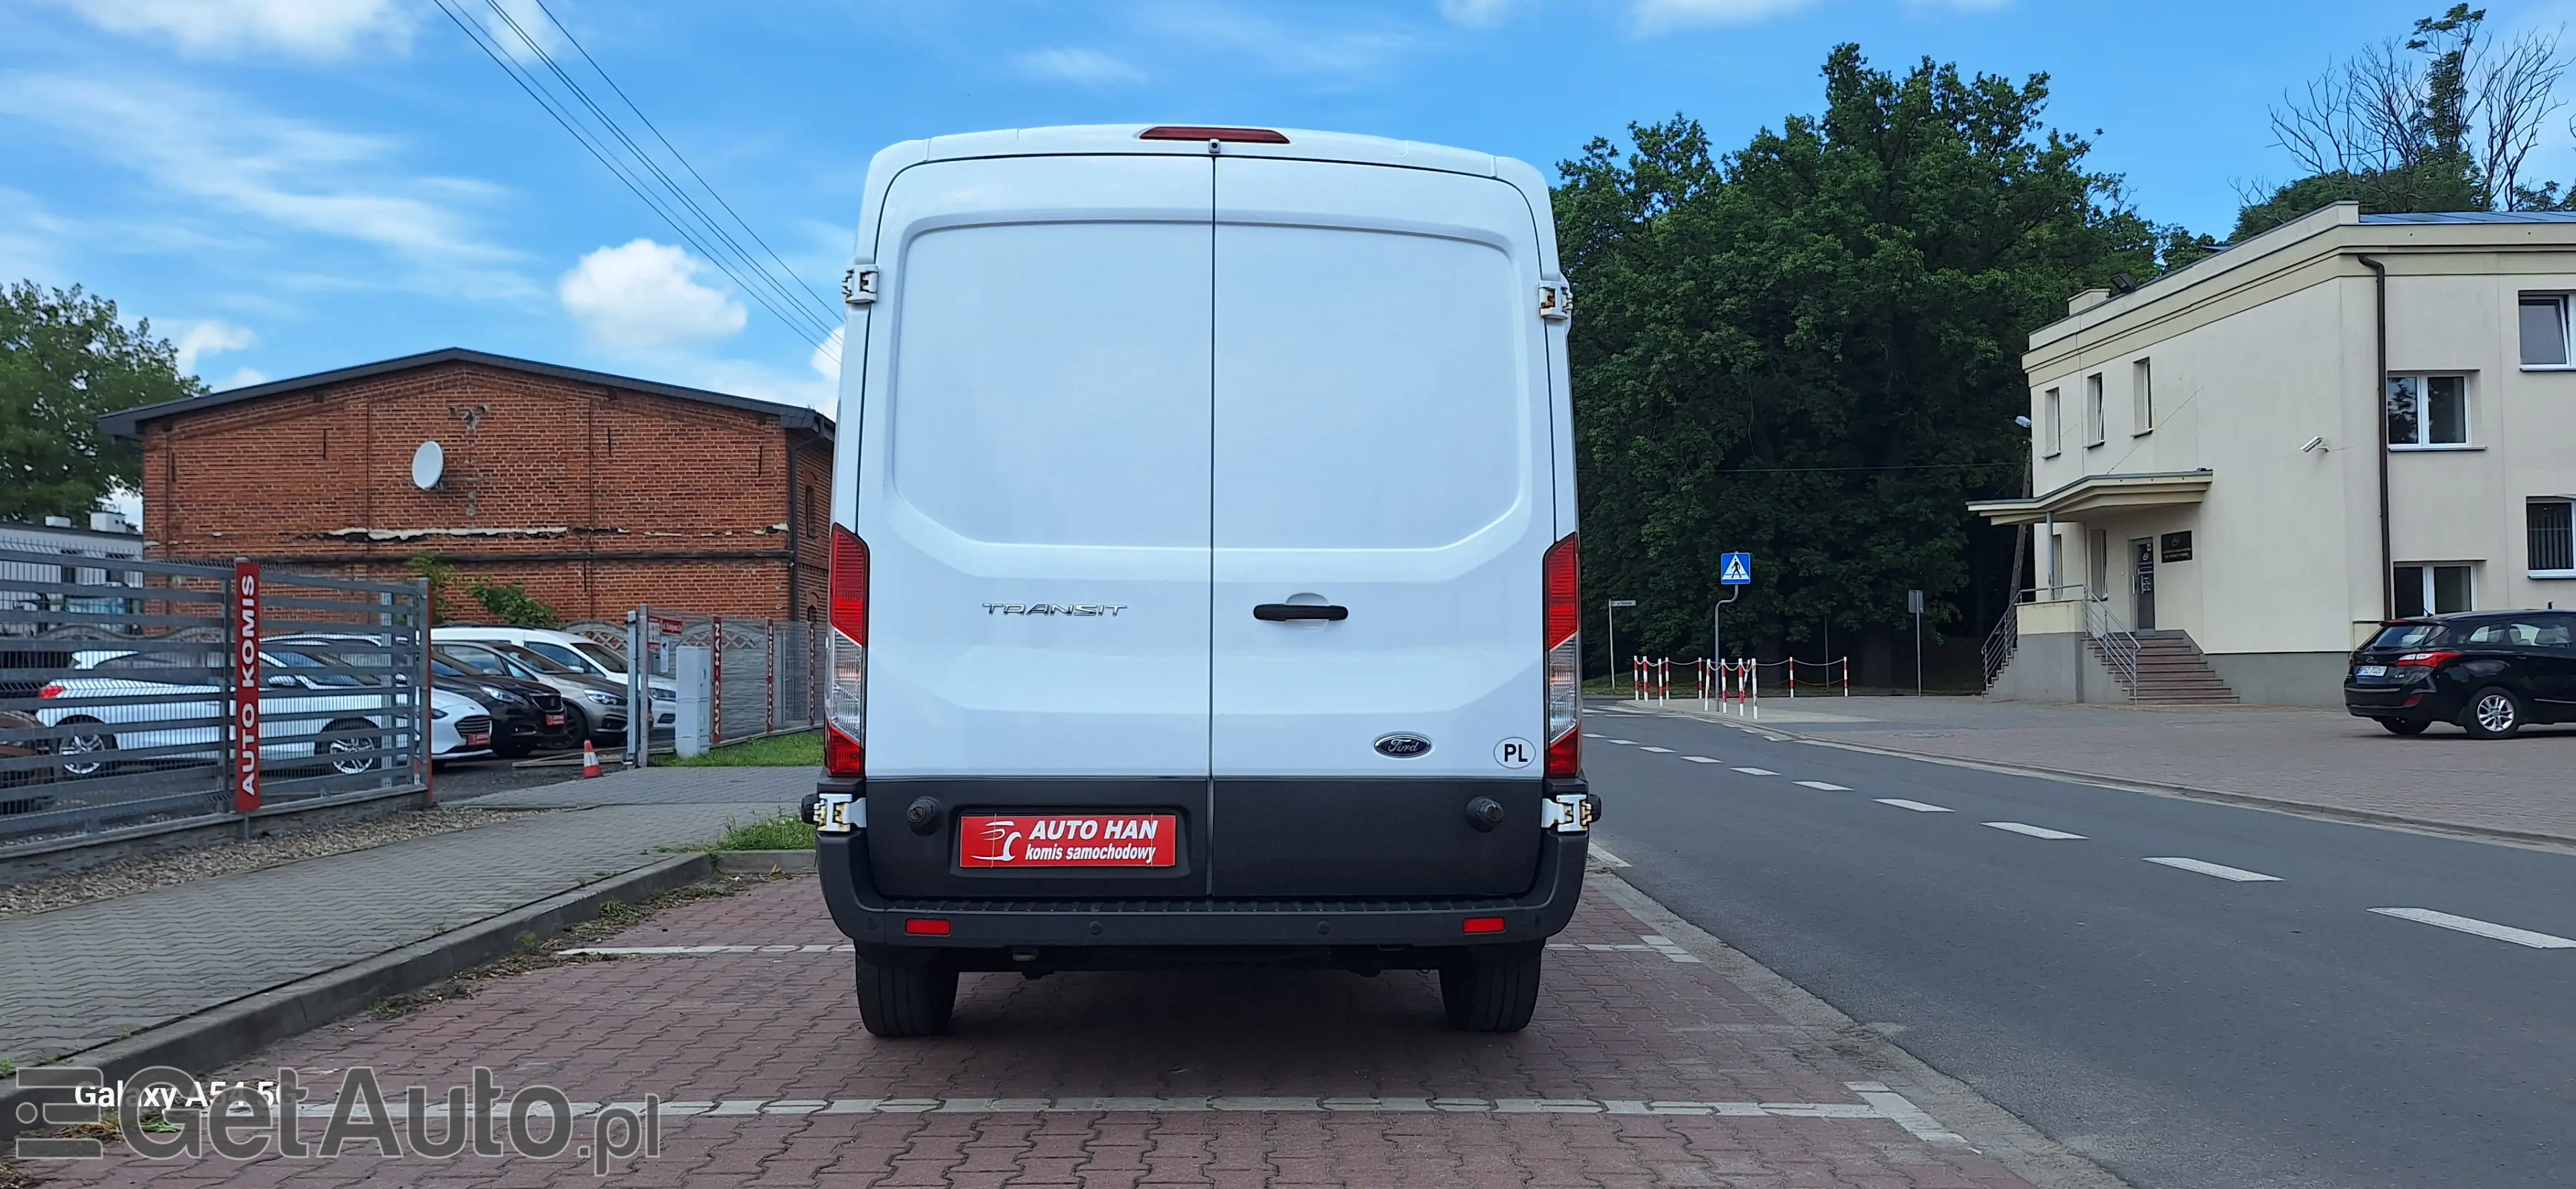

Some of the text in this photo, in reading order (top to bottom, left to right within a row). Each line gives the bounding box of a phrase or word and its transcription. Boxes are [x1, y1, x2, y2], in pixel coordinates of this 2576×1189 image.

[982, 603, 1128, 617] TRANSIT
[242, 575, 255, 796] AUTO KOMIS
[1388, 739, 1419, 752] Ford
[1504, 744, 1528, 762] PL
[1028, 820, 1159, 840] AUTO HAN
[1025, 844, 1157, 864] komis samochodowy
